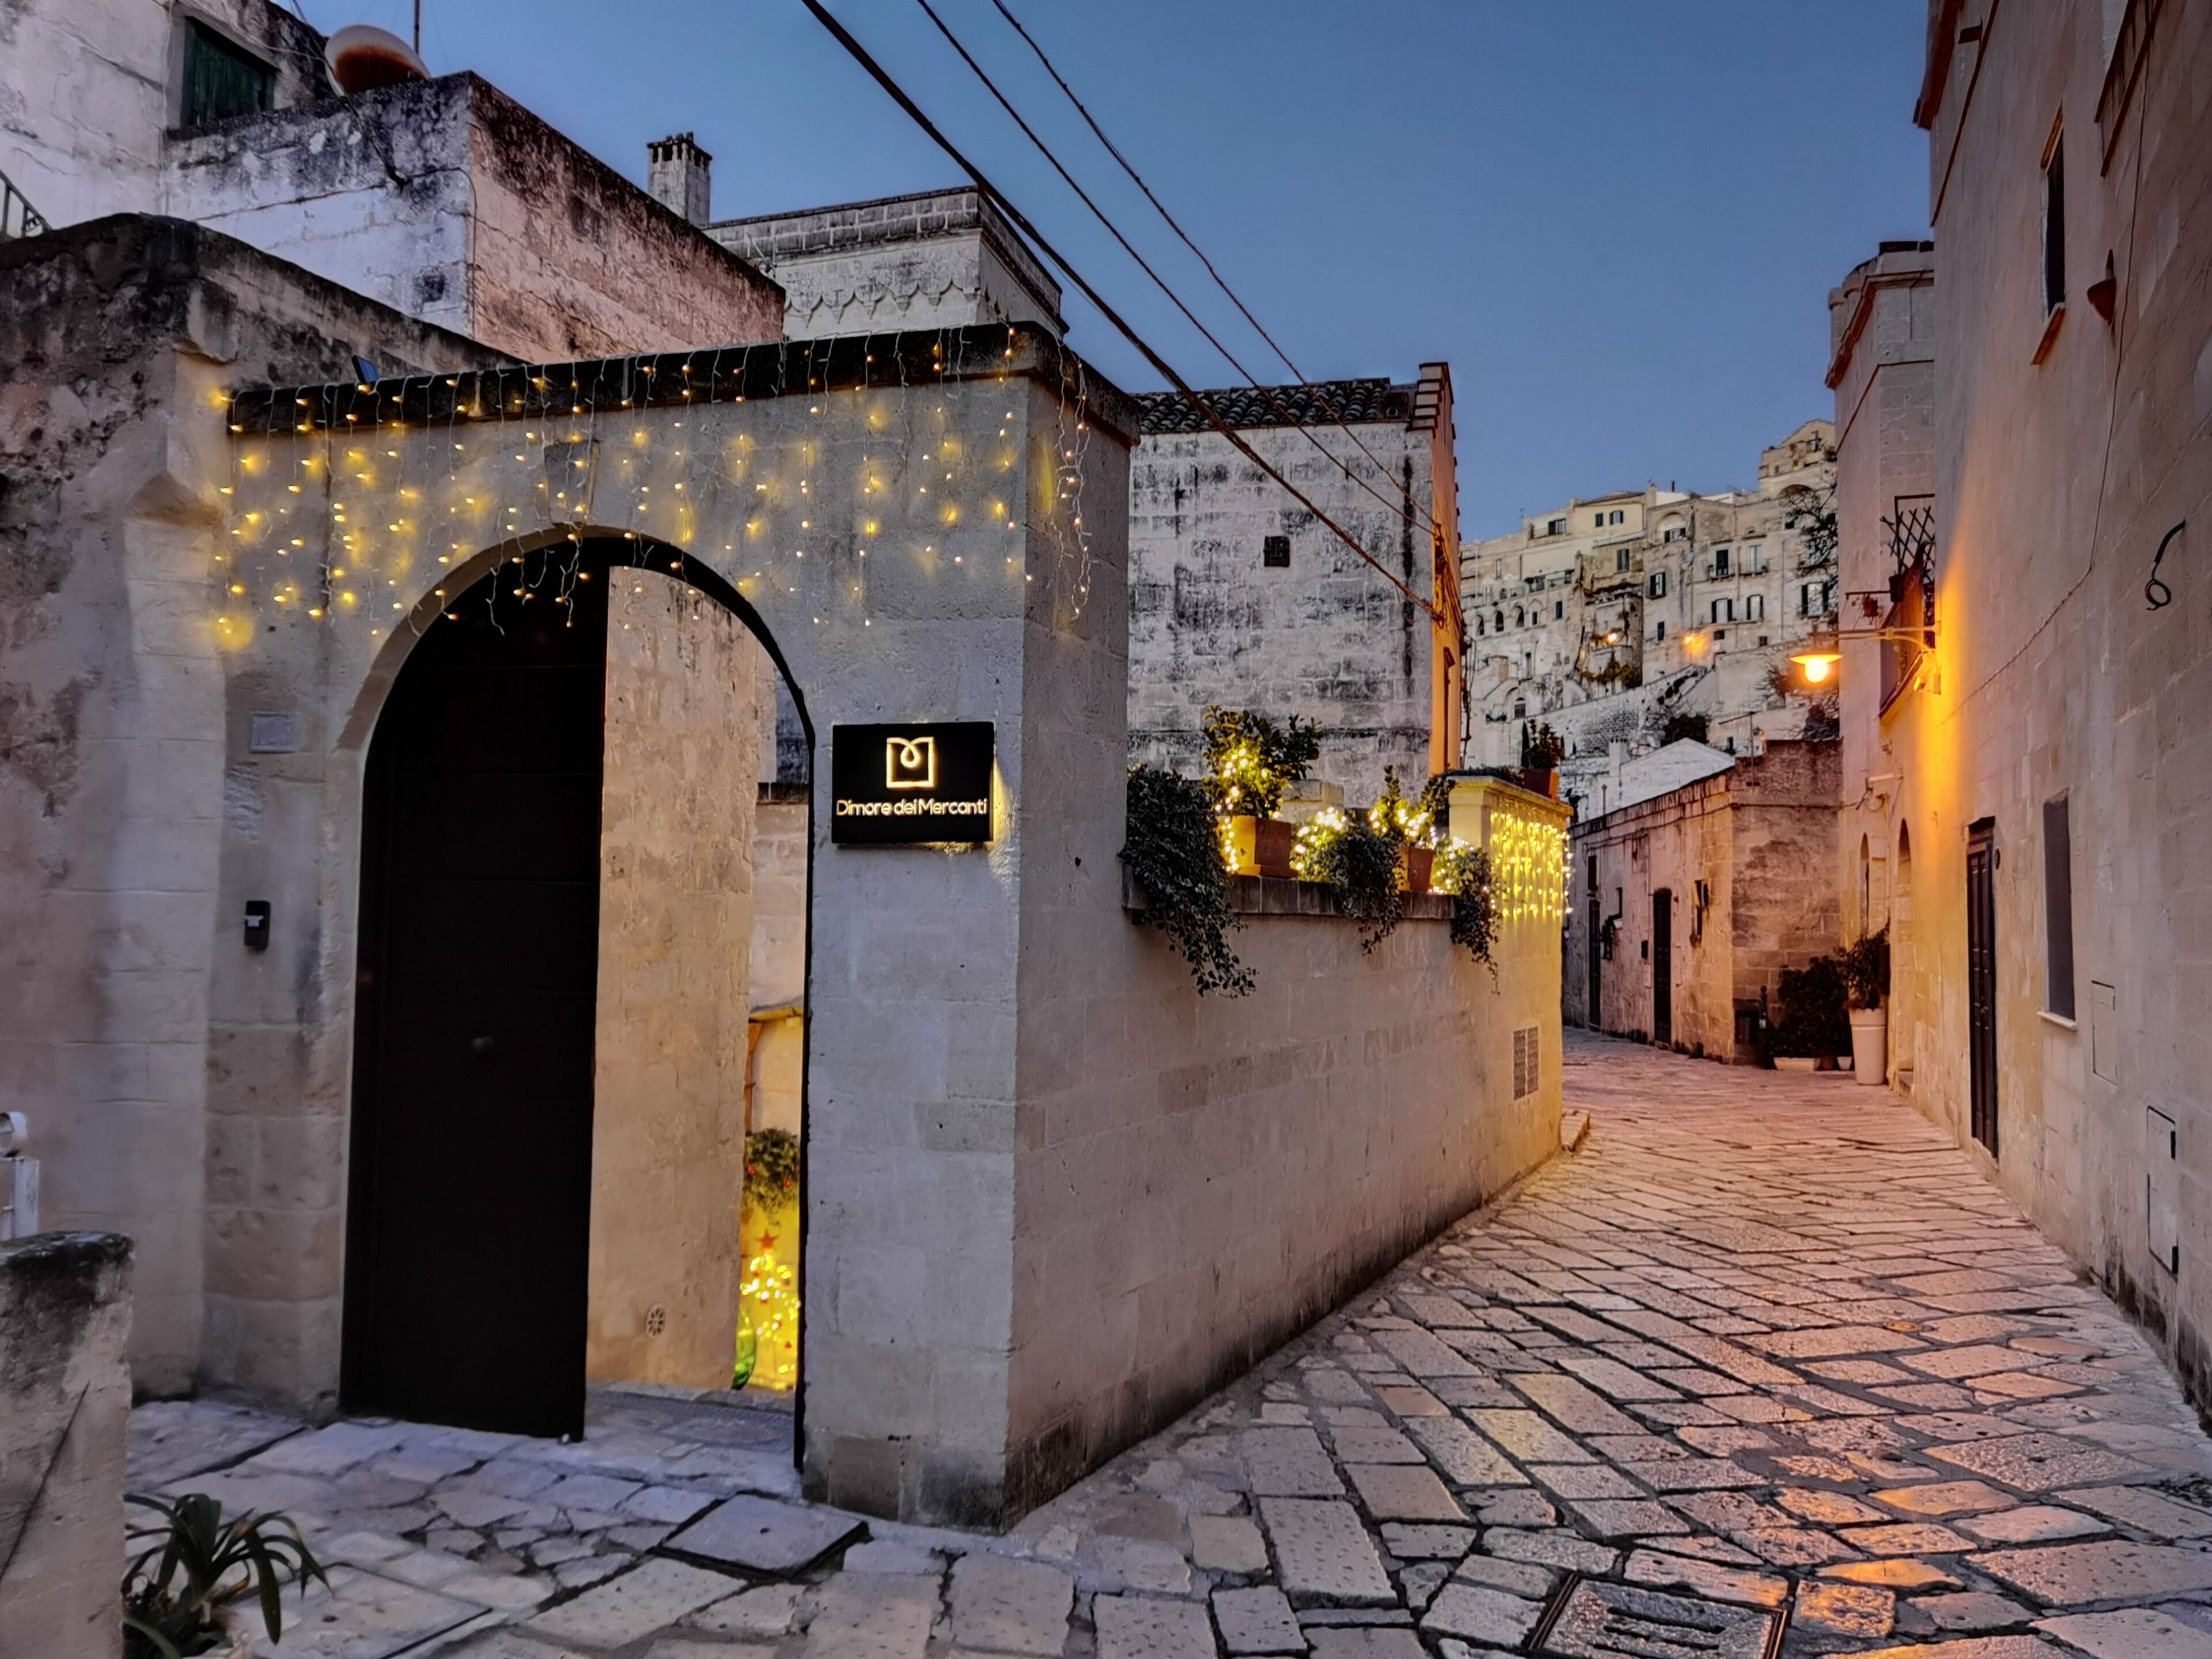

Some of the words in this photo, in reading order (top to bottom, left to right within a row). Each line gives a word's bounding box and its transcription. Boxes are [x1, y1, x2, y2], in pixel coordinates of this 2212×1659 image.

[836, 798, 893, 816] Dimore
[893, 798, 916, 815] dei
[919, 798, 987, 815] Mercanti
